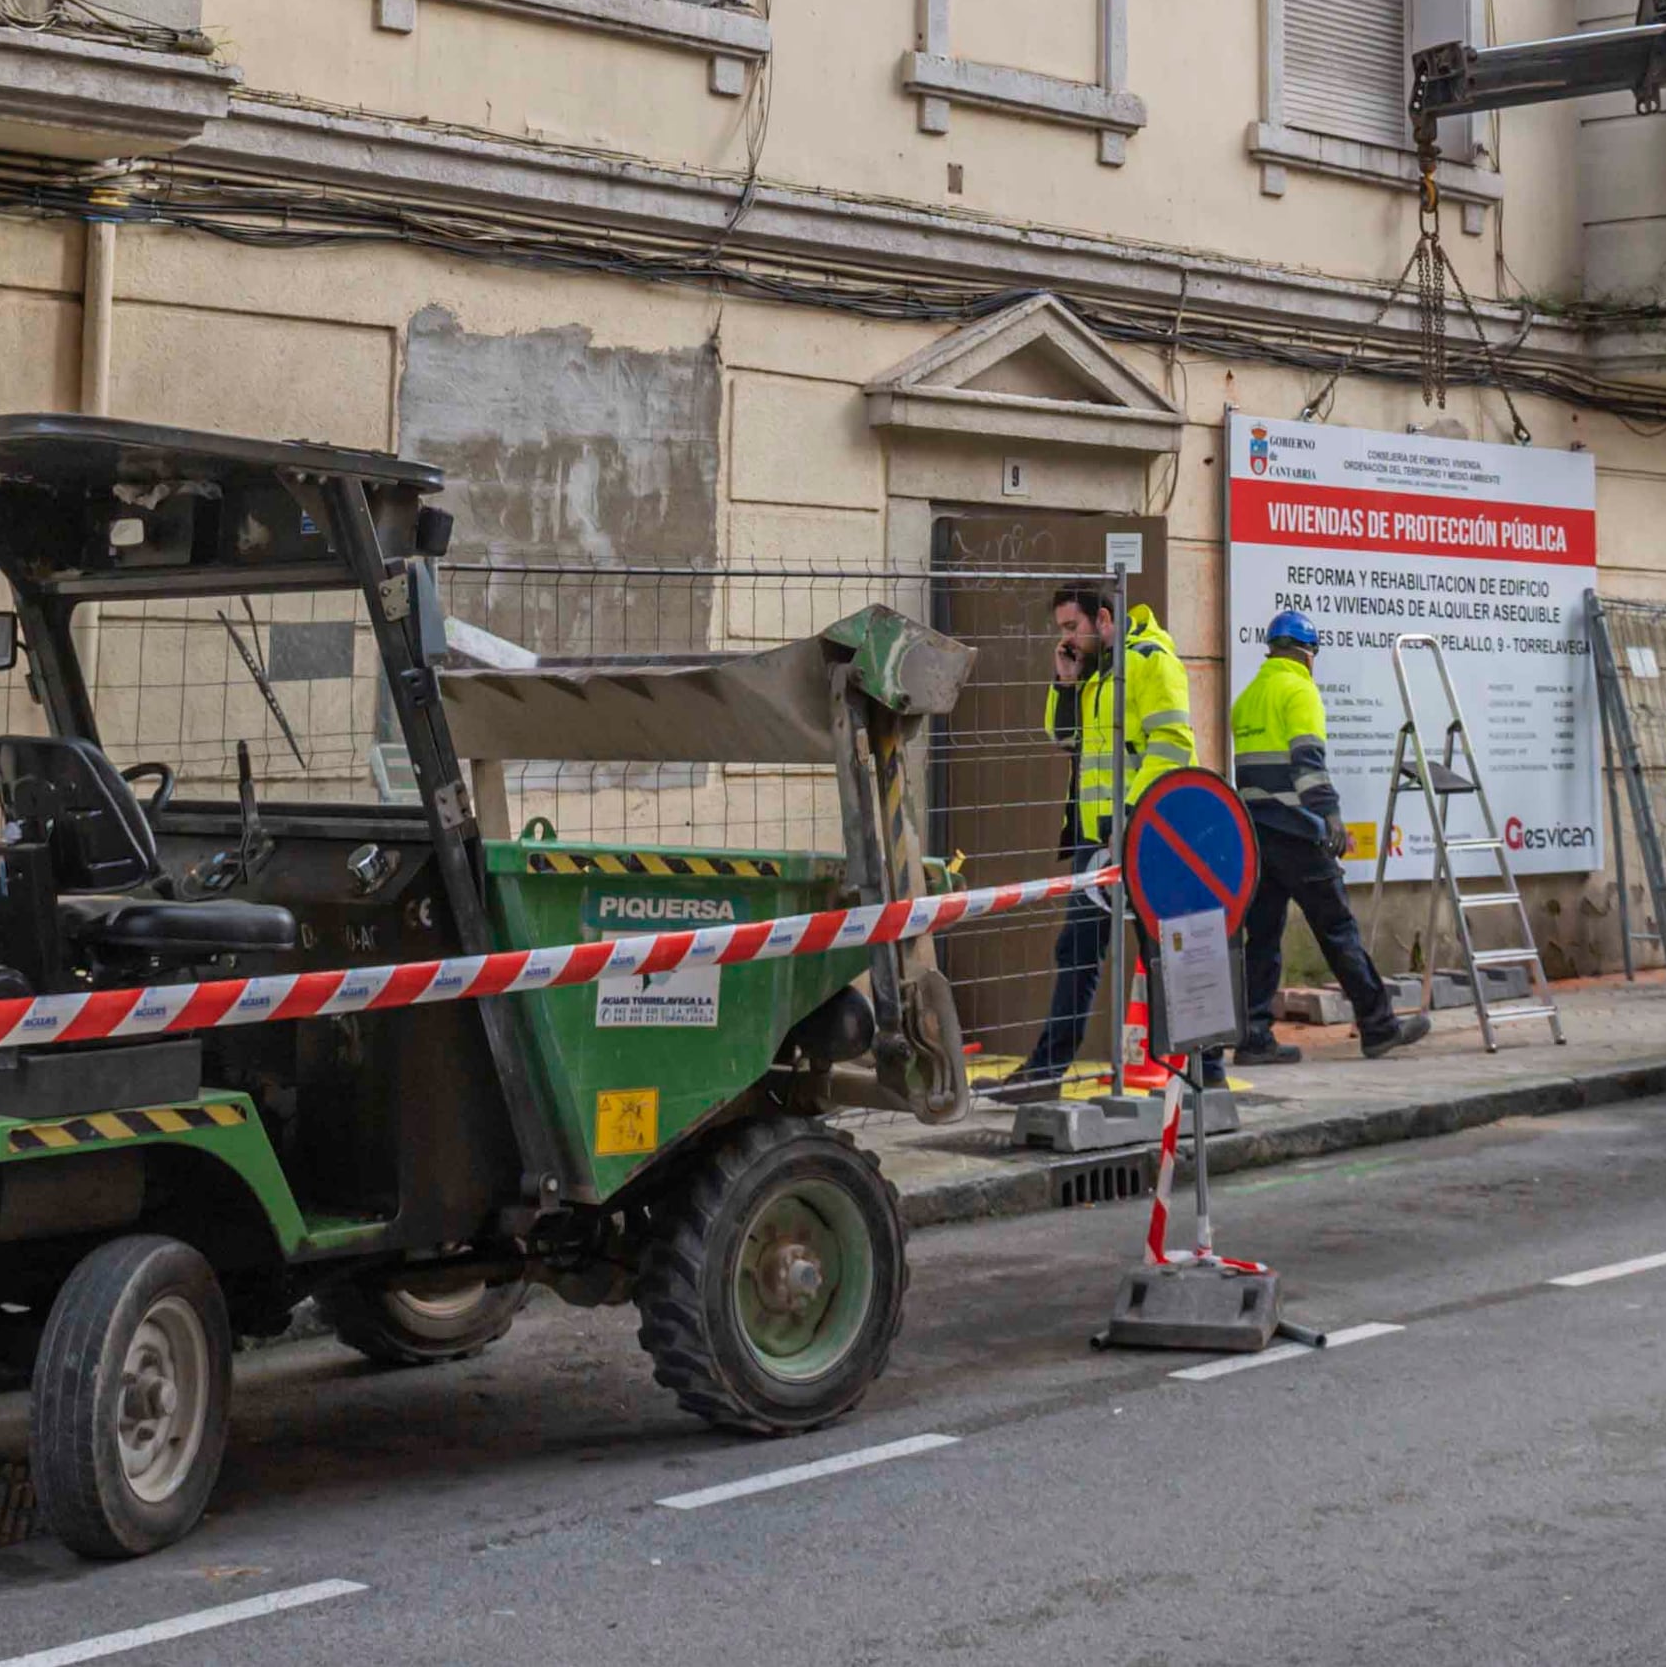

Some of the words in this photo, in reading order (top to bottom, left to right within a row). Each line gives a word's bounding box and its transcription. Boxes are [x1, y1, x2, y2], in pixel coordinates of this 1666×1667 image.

[1269, 436, 1315, 450] GOBIERNO
[1269, 465, 1317, 480] CANTABRIA
[1267, 501, 1363, 539] VIVIENDAS
[1367, 510, 1390, 540] DE
[1394, 513, 1498, 548] PROTECCIÓN
[1501, 517, 1567, 552] PÚBLICA
[1287, 566, 1355, 587] REFORMA
[1359, 570, 1367, 587] Y
[1370, 571, 1475, 593] REHABILITACION
[1480, 578, 1496, 595] DE
[1499, 579, 1549, 598] EDIFICIO
[1275, 592, 1313, 612] PARA
[1316, 595, 1331, 613] 12
[1334, 596, 1405, 616] VIVIENDAS
[1408, 599, 1425, 617] DE
[1428, 601, 1489, 621] ALQUILER
[1493, 604, 1561, 624] ASEQUIBLE
[1239, 627, 1253, 644] C/
[1337, 631, 1353, 647] DE
[1498, 636, 1504, 653] 9
[1514, 637, 1591, 655] TORRELAVEGA
[1504, 816, 1595, 851] Gesvican
[599, 896, 735, 920] PIQUERSA
